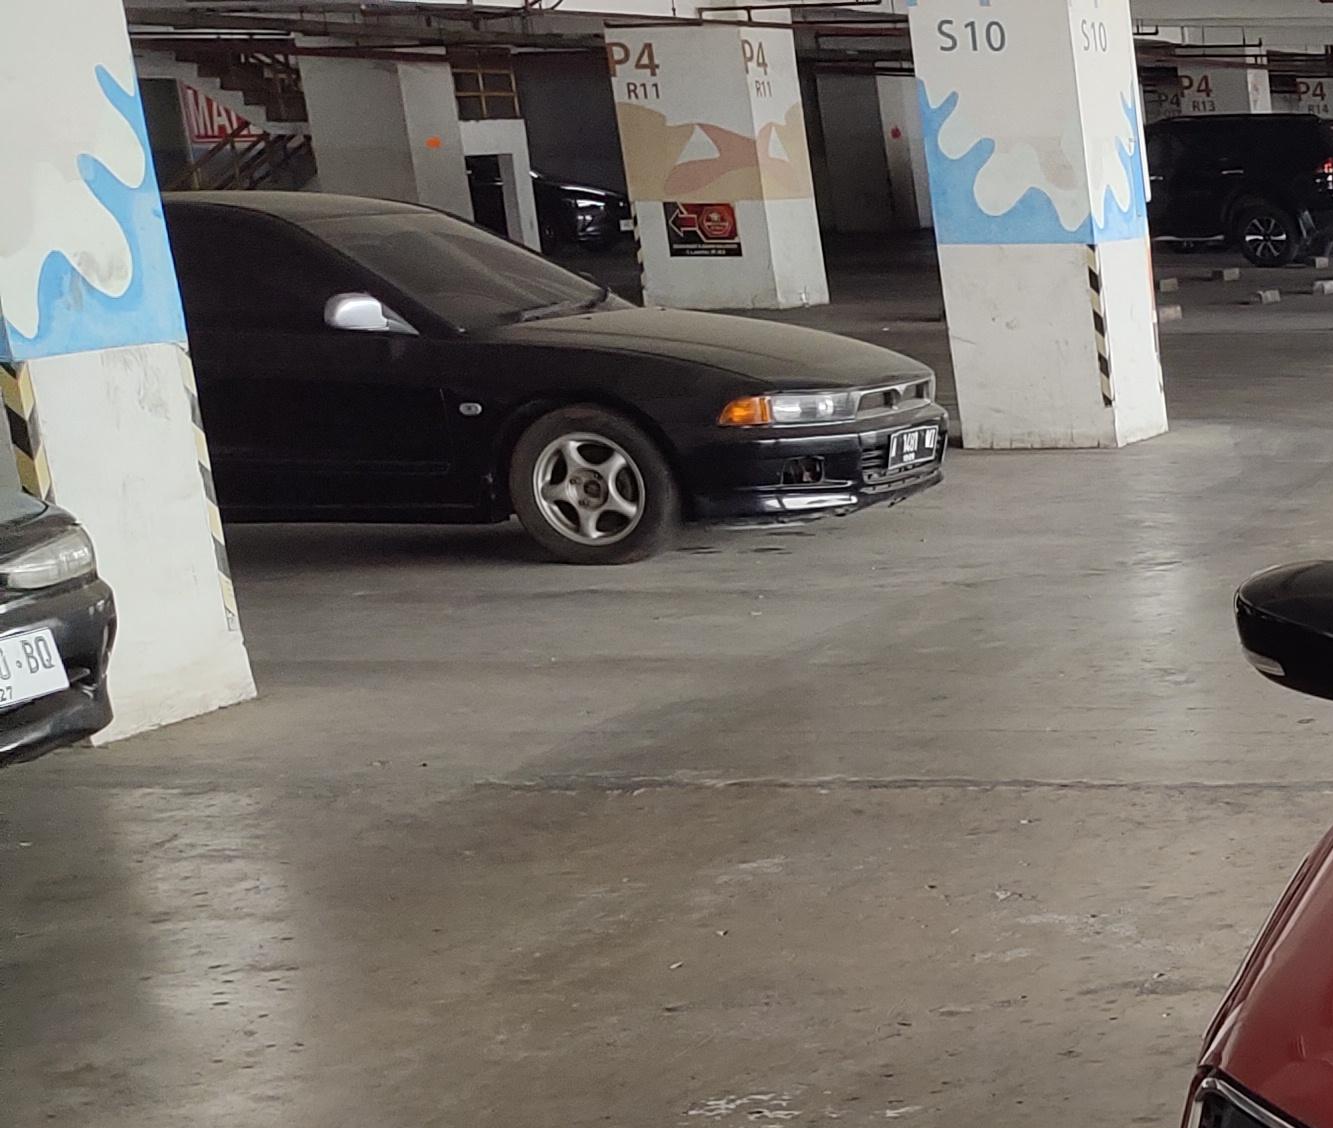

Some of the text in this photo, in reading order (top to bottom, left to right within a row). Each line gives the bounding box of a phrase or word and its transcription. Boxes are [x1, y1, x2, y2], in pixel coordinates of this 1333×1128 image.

[937, 19, 1006, 51] S10
[1081, 19, 1108, 52] S10
[605, 42, 660, 77] P4
[742, 39, 768, 76] P4
[627, 82, 661, 99] R11
[755, 80, 772, 97] R11
[1179, 75, 1213, 98] P4
[1297, 81, 1326, 101] P4
[1192, 101, 1216, 112] R13
[22, 636, 55, 674] BQ
